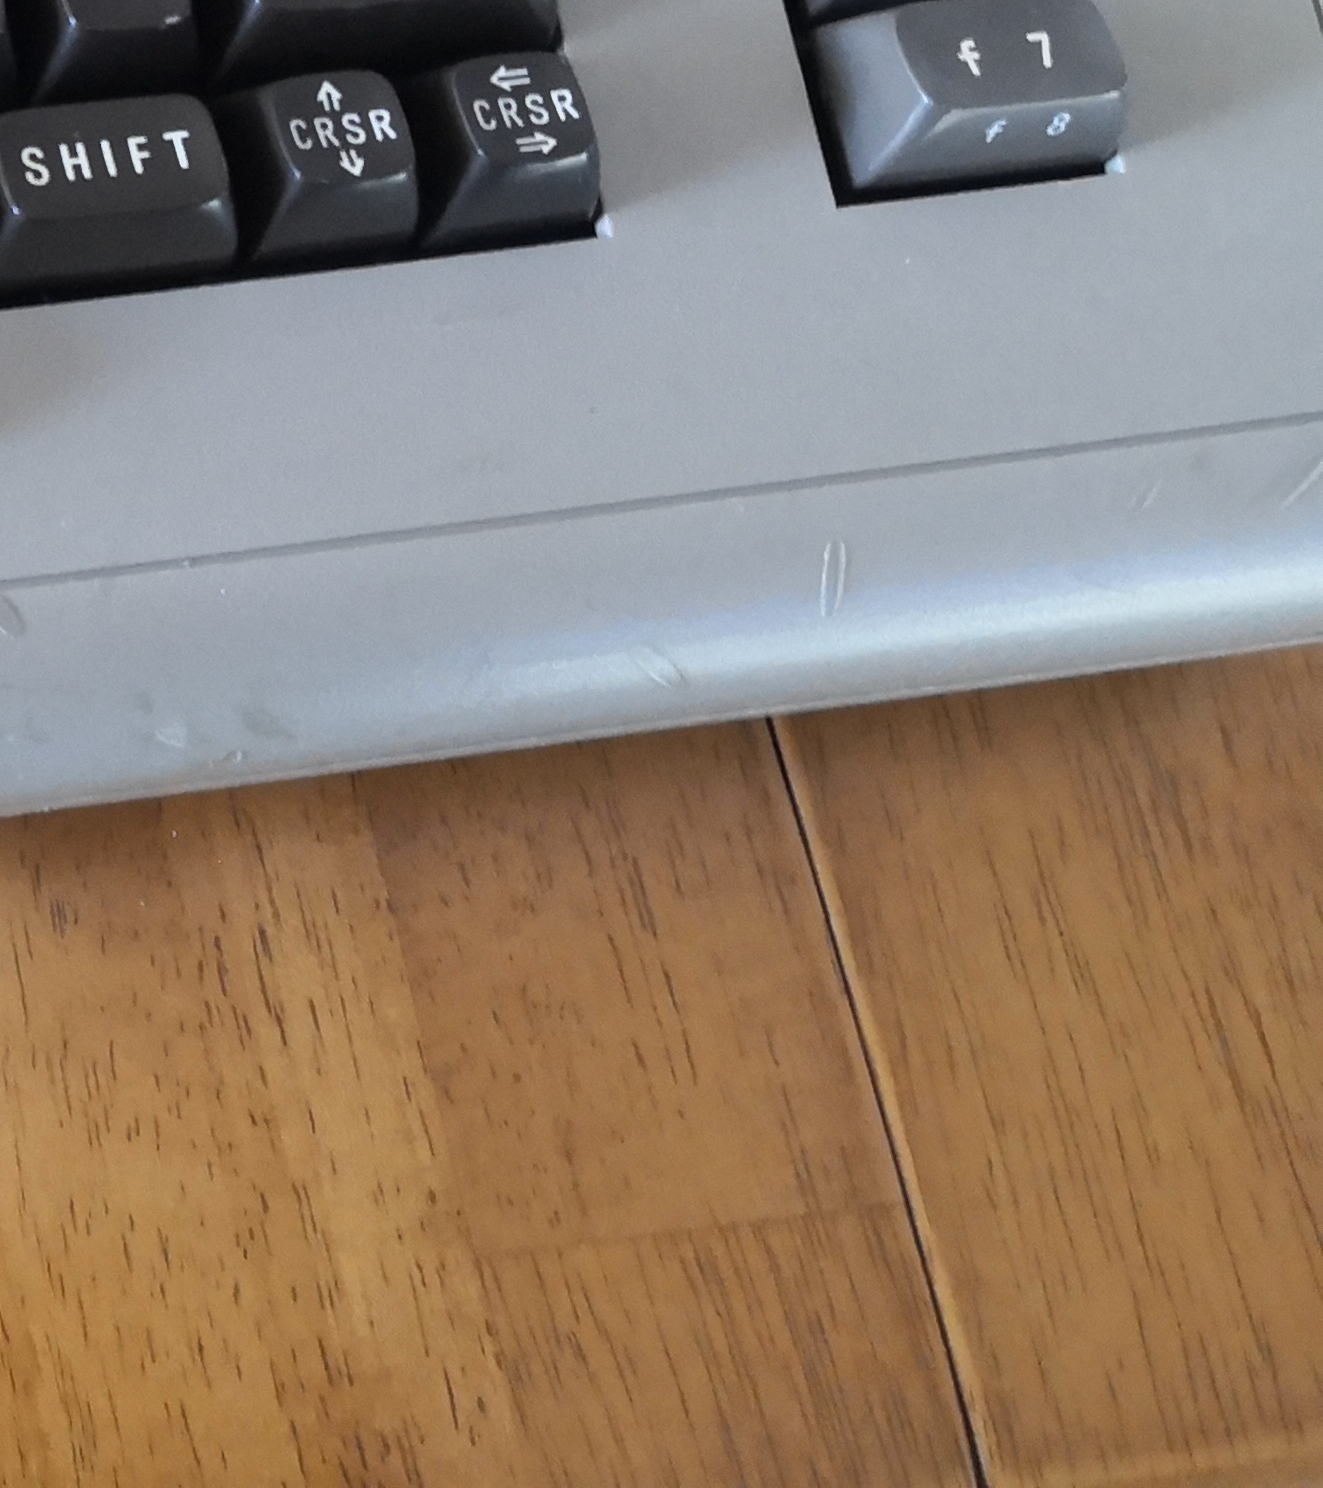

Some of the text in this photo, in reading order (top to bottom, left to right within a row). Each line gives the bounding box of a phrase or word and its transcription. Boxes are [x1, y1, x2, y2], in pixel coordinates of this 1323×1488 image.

[289, 104, 398, 150] CRSR
[473, 84, 580, 131] CRSR
[21, 129, 190, 186] SHIFT
